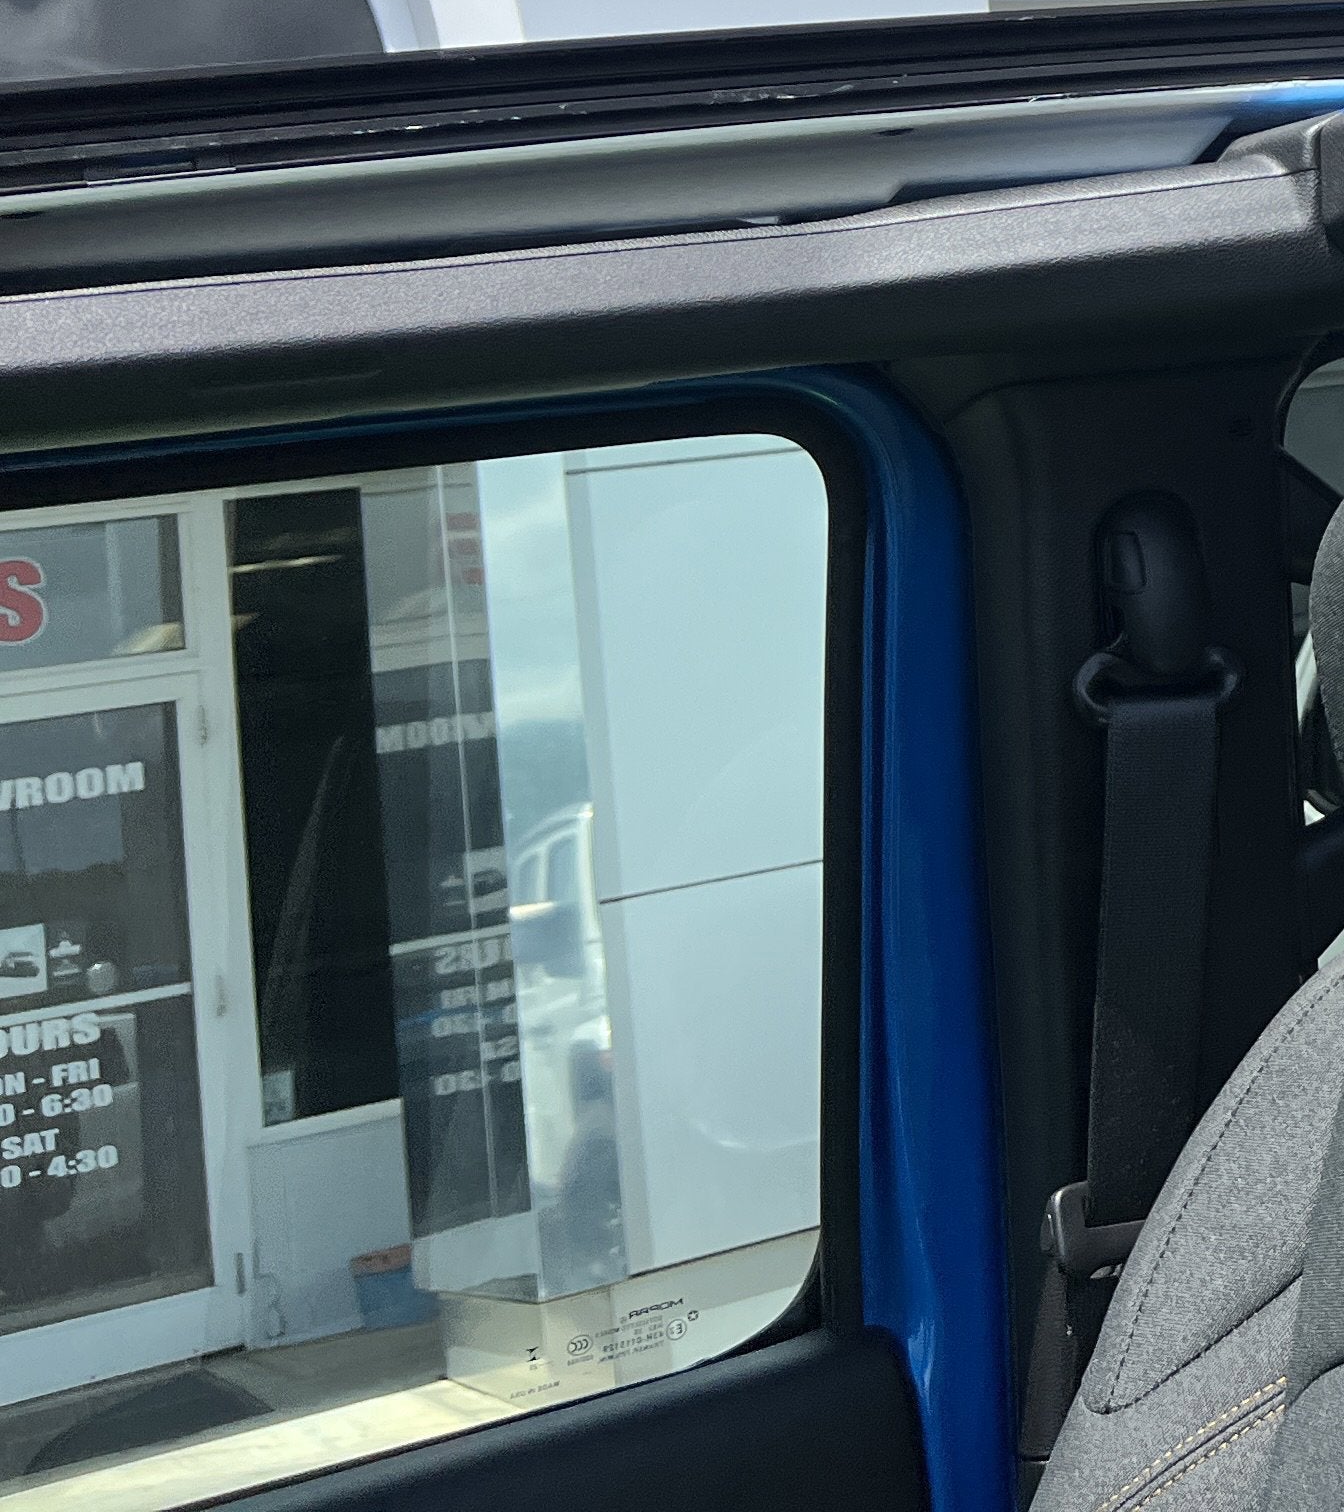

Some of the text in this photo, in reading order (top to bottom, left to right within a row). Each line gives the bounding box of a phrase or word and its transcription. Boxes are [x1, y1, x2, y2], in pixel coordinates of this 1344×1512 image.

[51, 1057, 101, 1087] FRI
[41, 1083, 114, 1118] 6:30
[1, 1128, 60, 1160] SAT
[47, 1144, 119, 1178] 4:30
